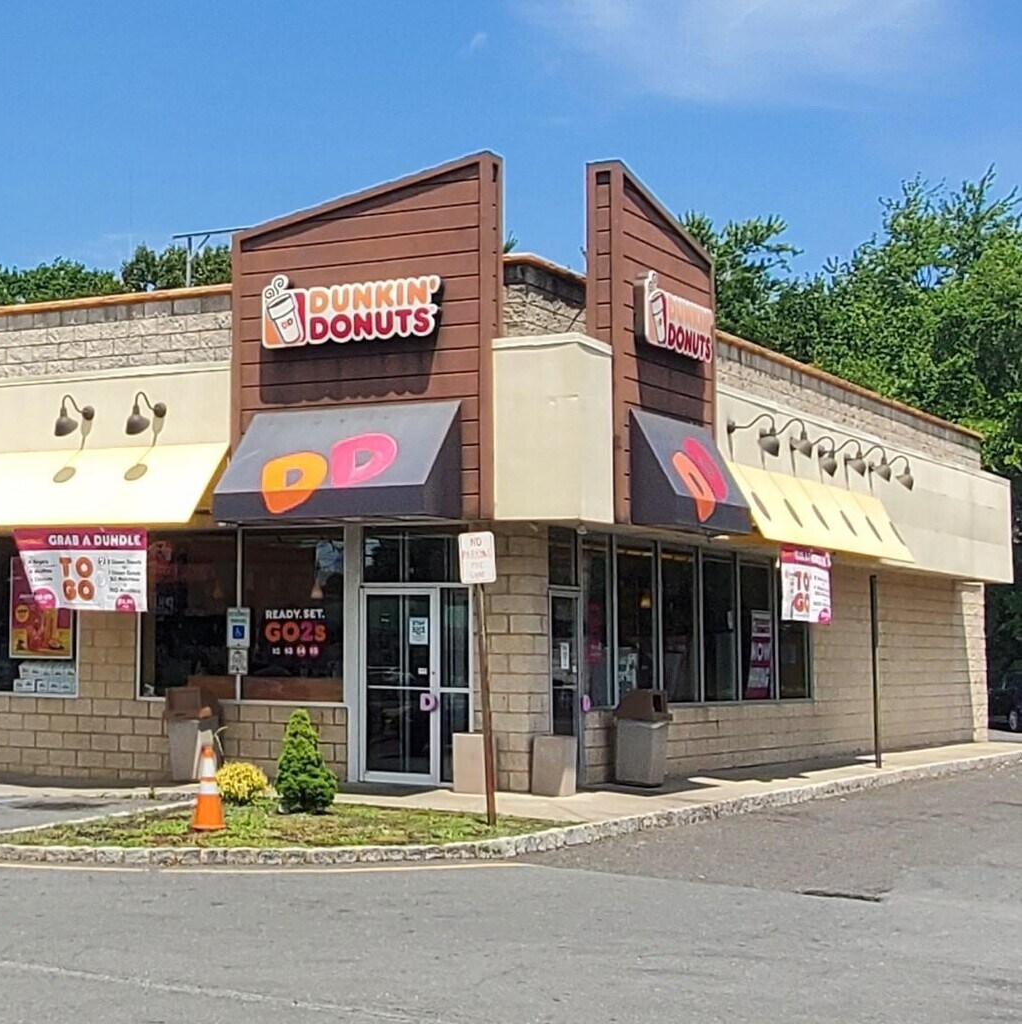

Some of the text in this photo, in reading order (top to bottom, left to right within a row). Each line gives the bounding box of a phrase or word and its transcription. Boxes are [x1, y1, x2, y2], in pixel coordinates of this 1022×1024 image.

[309, 277, 437, 314] DUNKIN'
[309, 307, 430, 341] DONUTS
[668, 322, 712, 361] DONUTS
[47, 534, 80, 546] GRAB
[82, 534, 92, 546] A
[470, 536, 482, 547] NO
[59, 556, 94, 578] TO
[62, 578, 95, 601] GO
